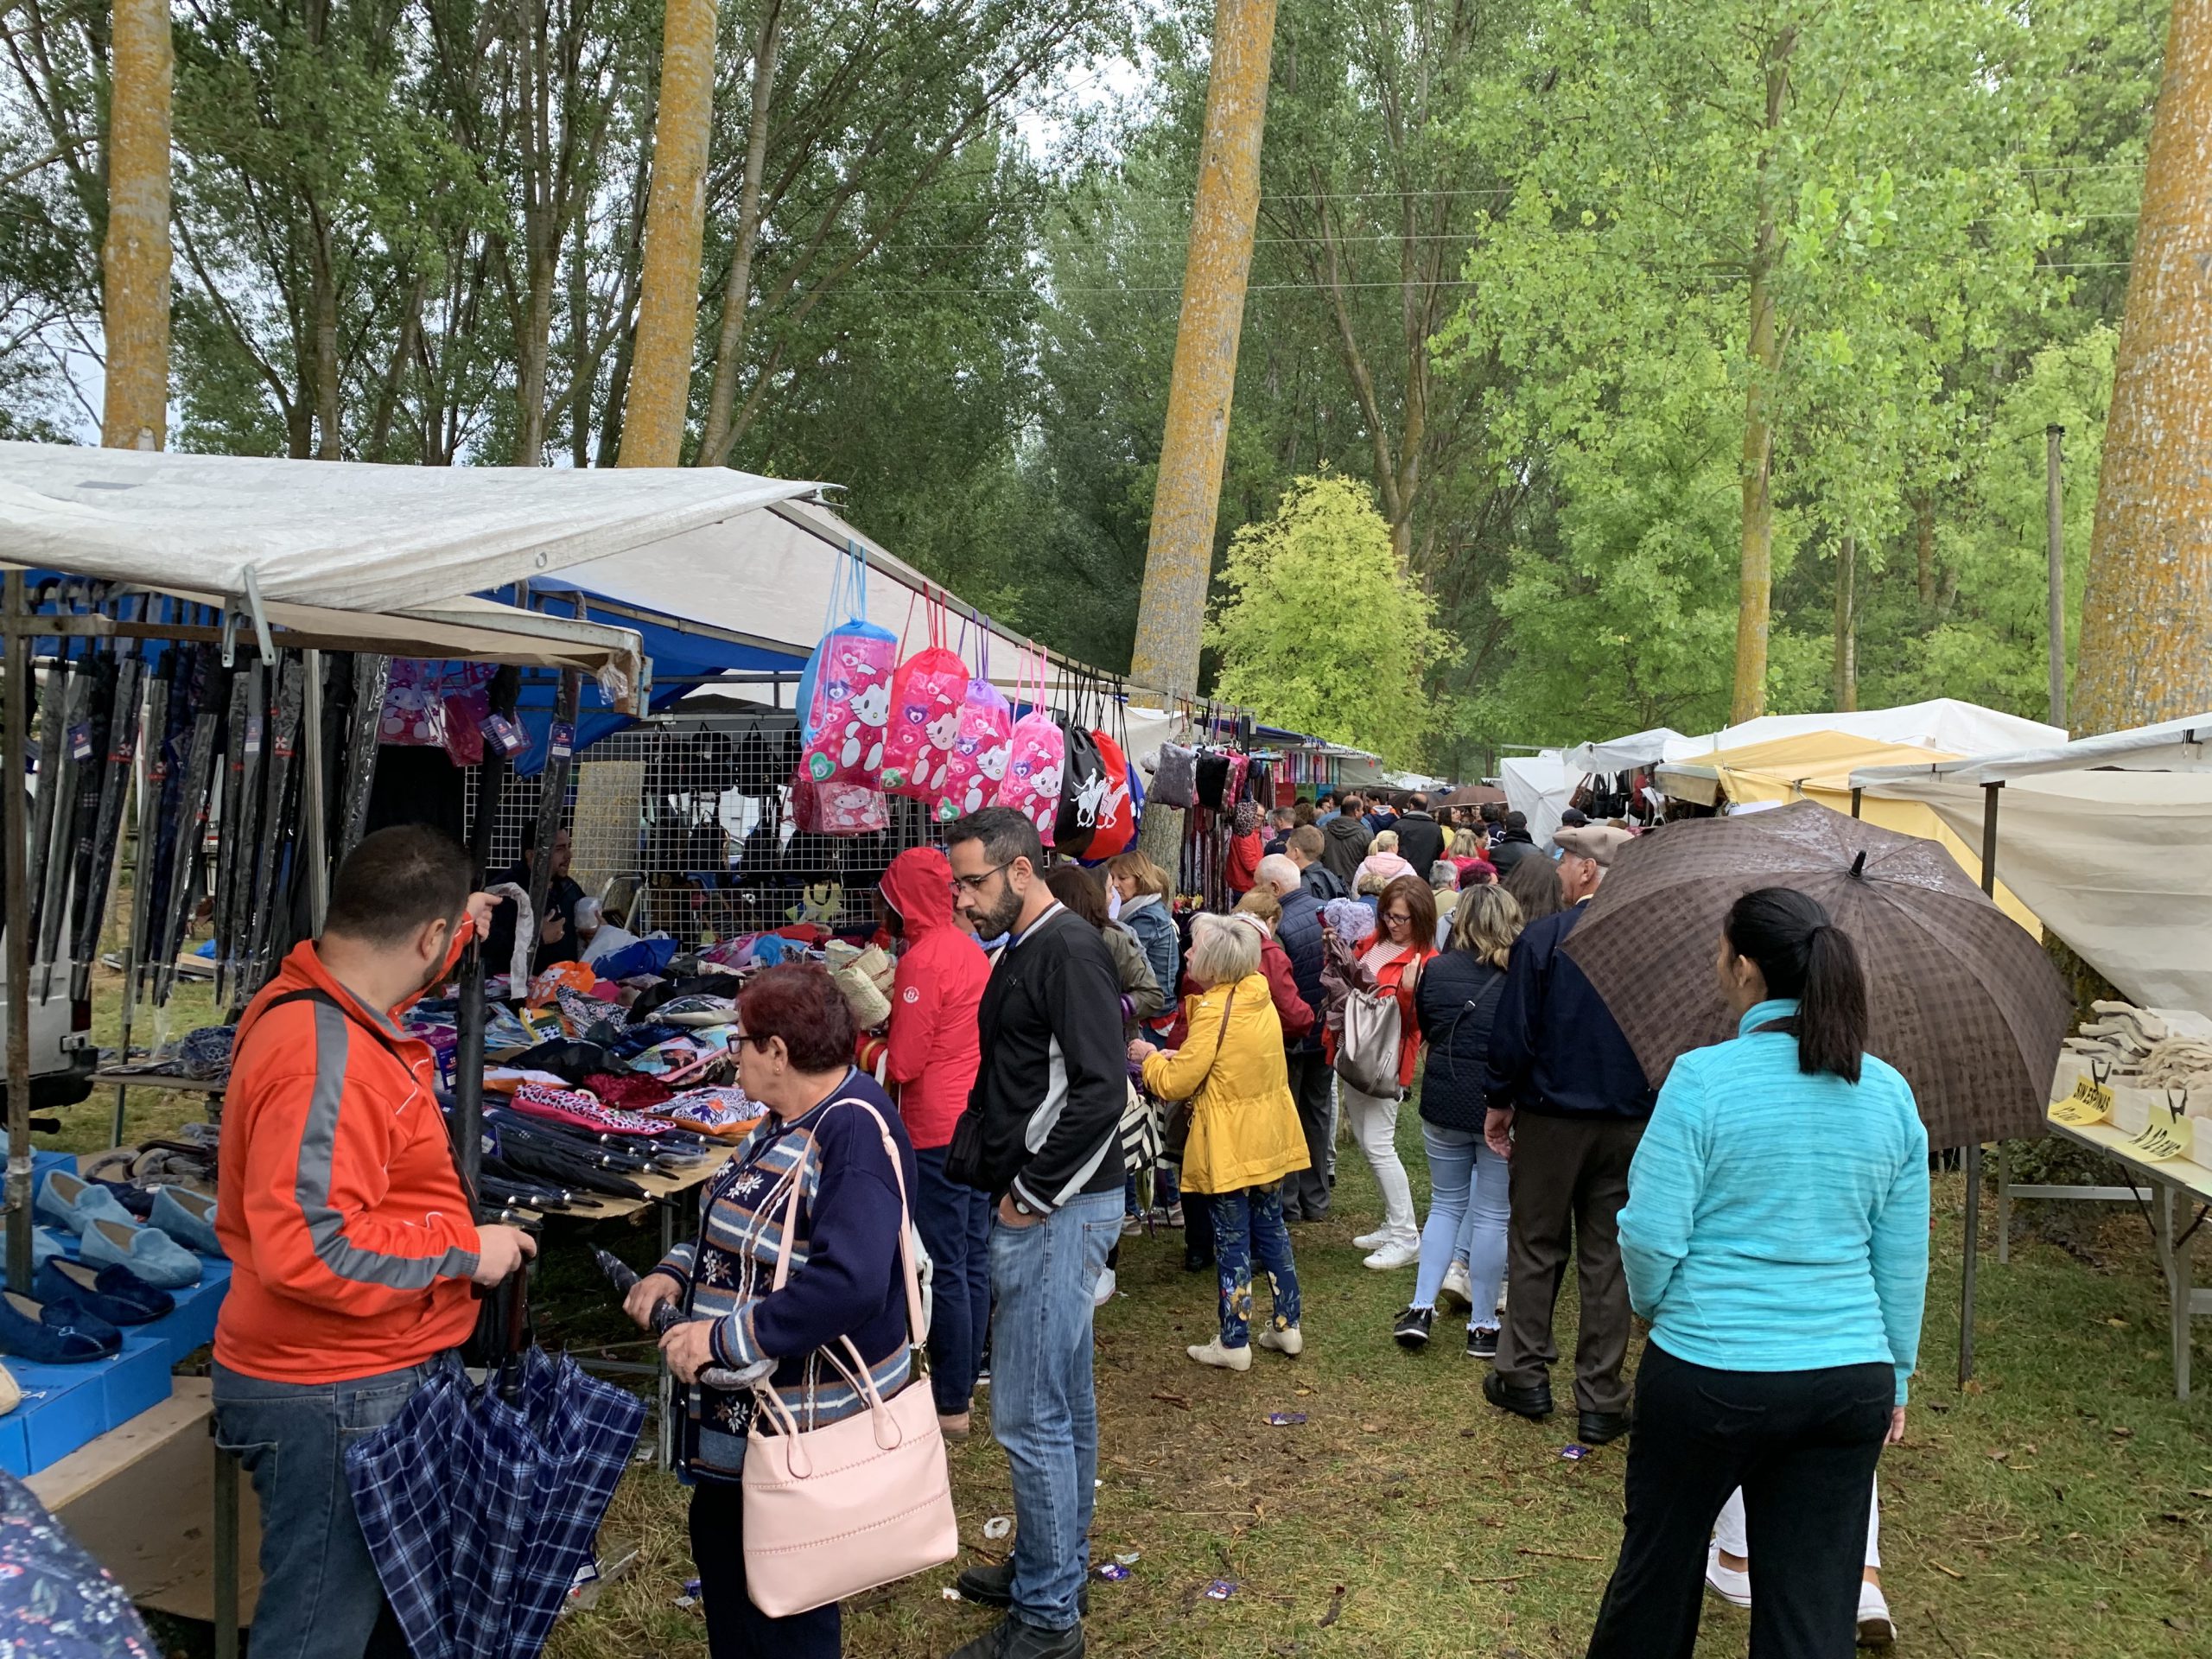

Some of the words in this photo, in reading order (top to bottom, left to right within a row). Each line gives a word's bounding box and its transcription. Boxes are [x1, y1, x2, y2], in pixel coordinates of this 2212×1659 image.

[2073, 1082, 2088, 1101] SIN
[2082, 1087, 2111, 1113] ESPINAS
[2138, 1128, 2168, 1150] 12
